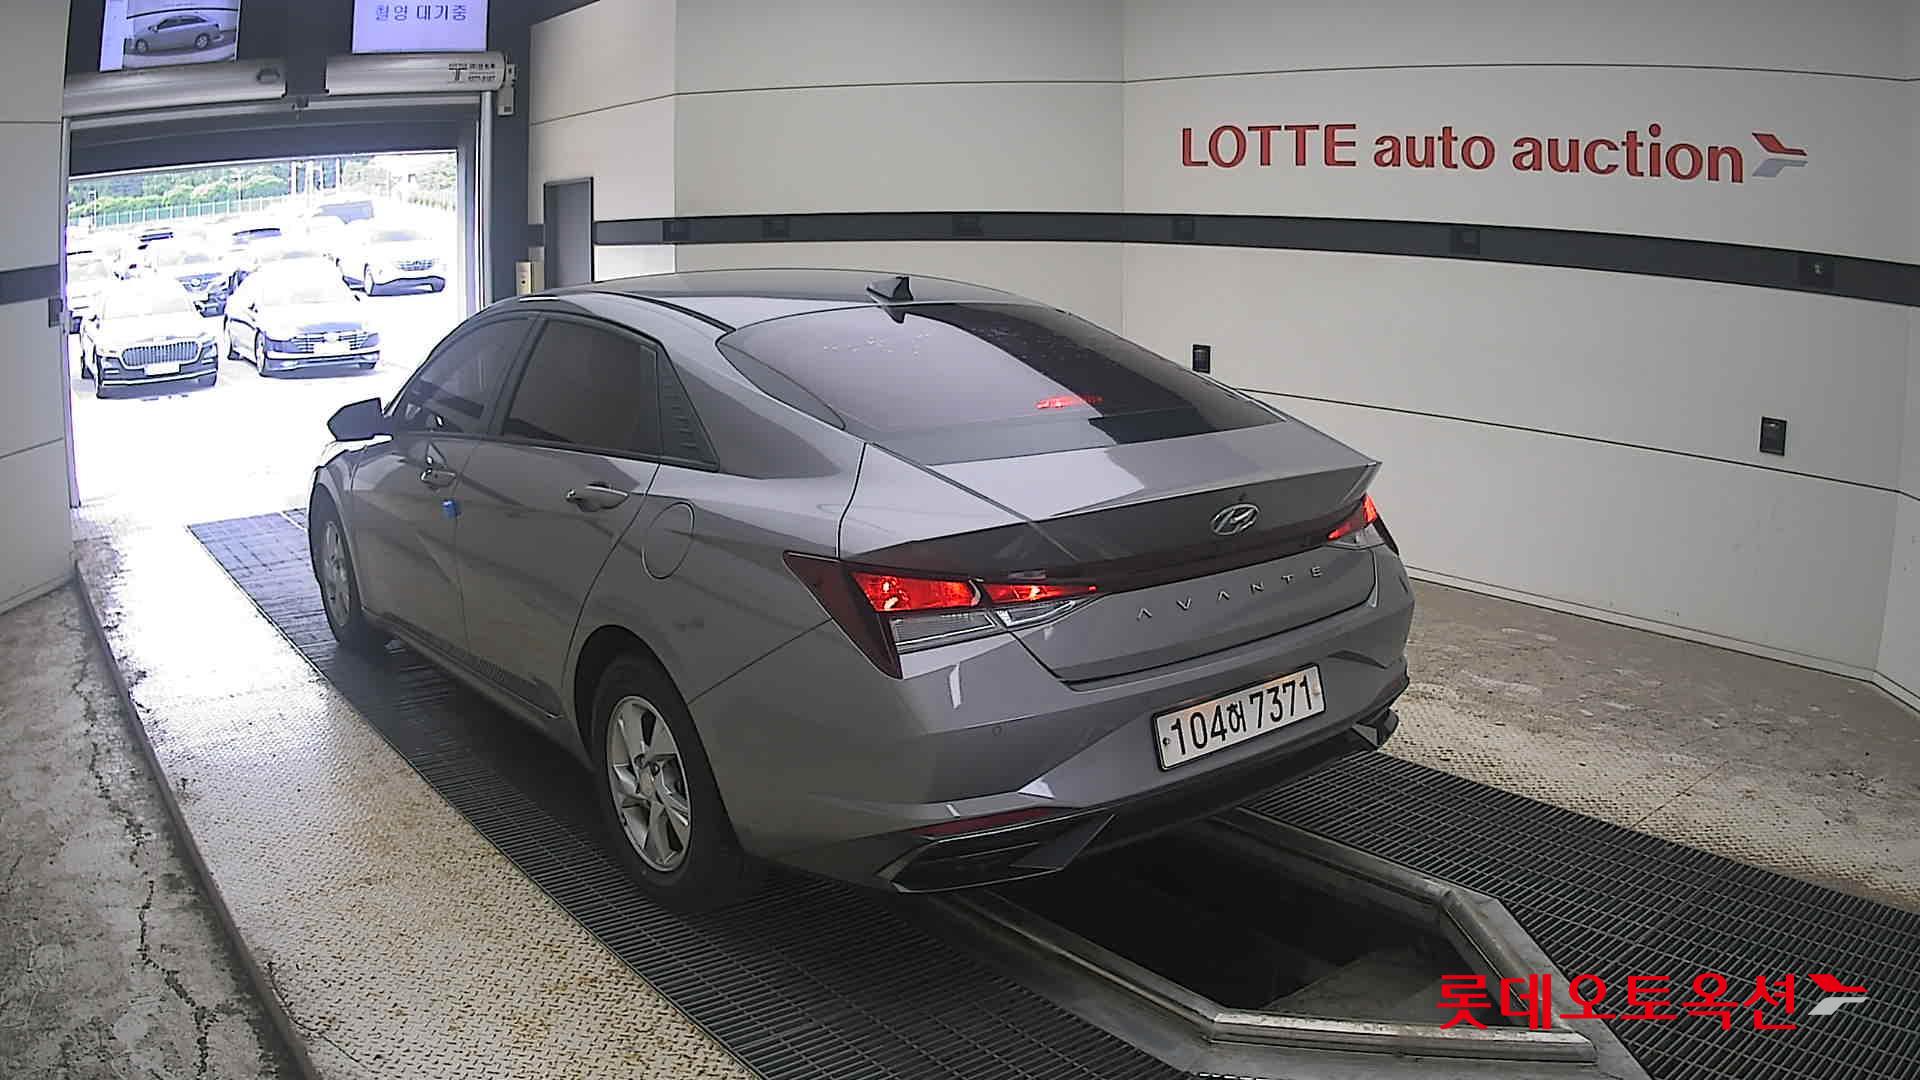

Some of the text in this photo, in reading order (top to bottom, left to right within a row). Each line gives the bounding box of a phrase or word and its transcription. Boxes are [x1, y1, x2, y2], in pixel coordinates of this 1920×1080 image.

[416, 4, 467, 21] 대기중
[1181, 123, 1744, 183] LOTTE auto auction
[1136, 566, 1323, 620] AVANTE
[1249, 675, 1312, 728] 7371
